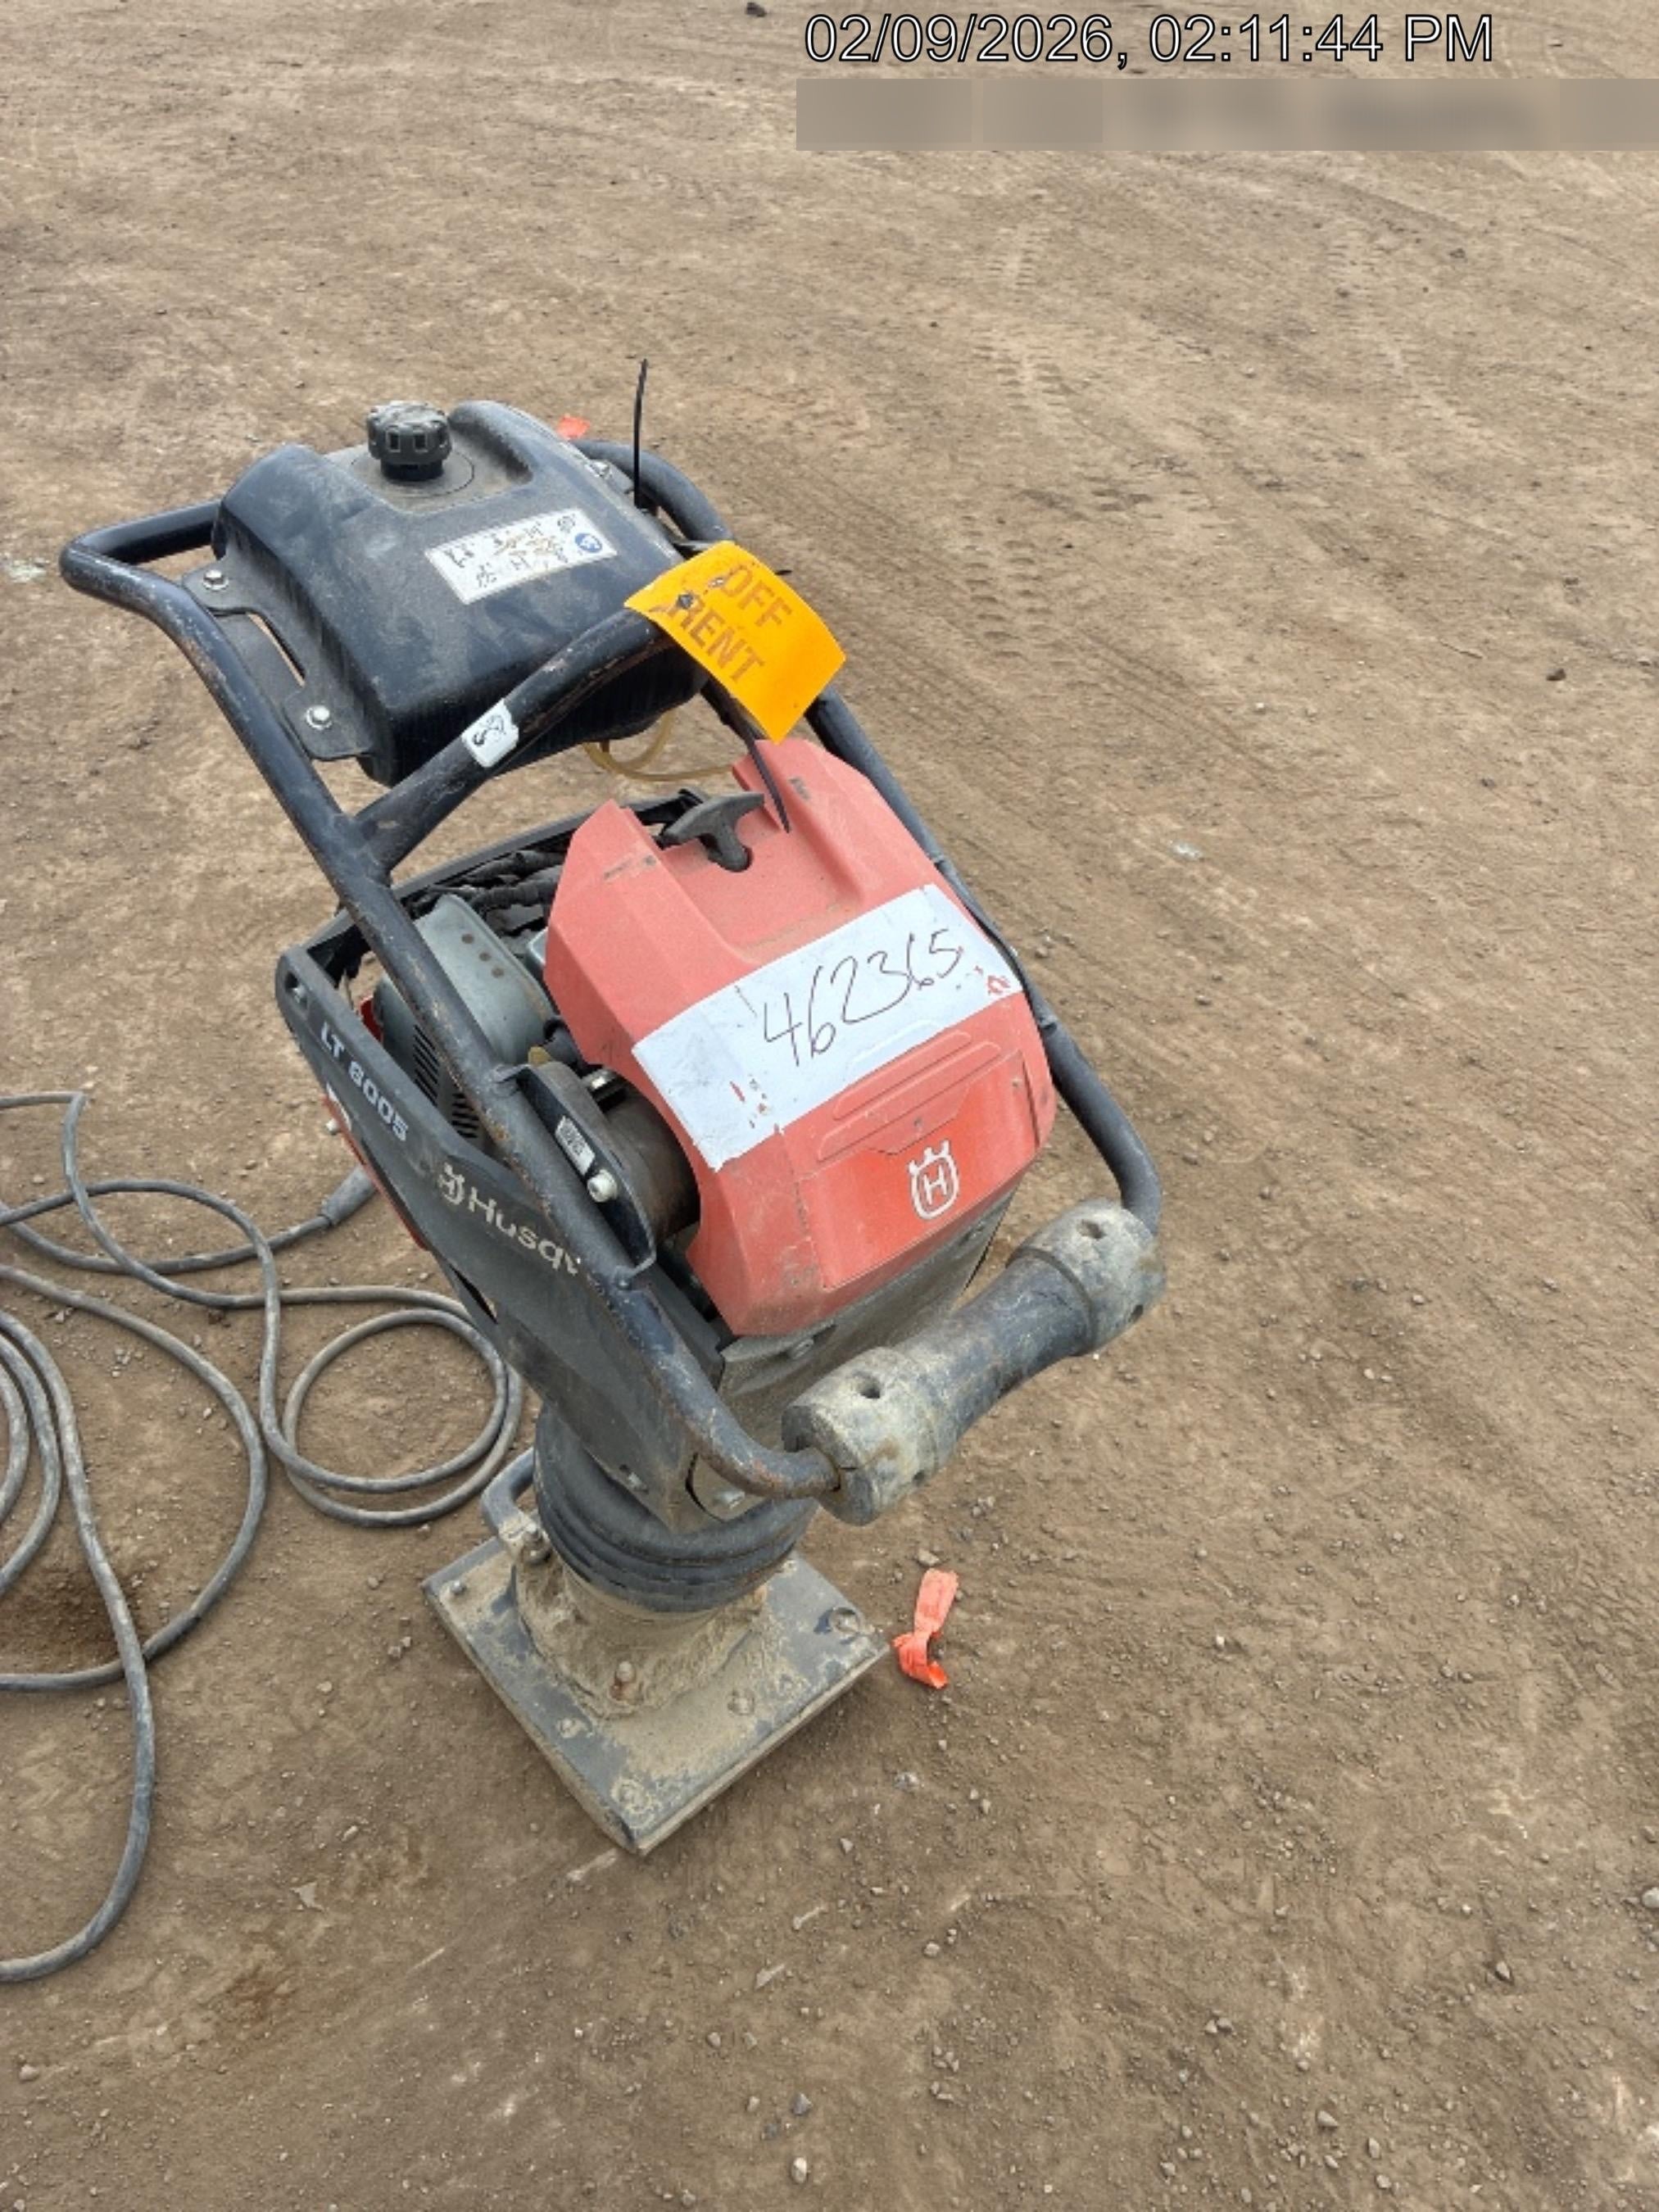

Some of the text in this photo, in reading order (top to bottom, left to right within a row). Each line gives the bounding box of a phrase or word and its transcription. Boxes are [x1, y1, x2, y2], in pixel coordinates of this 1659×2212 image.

[719, 565, 793, 628] OFF
[664, 591, 766, 682] RENT
[764, 928, 964, 1067] 462365
[320, 1022, 345, 1058] LT
